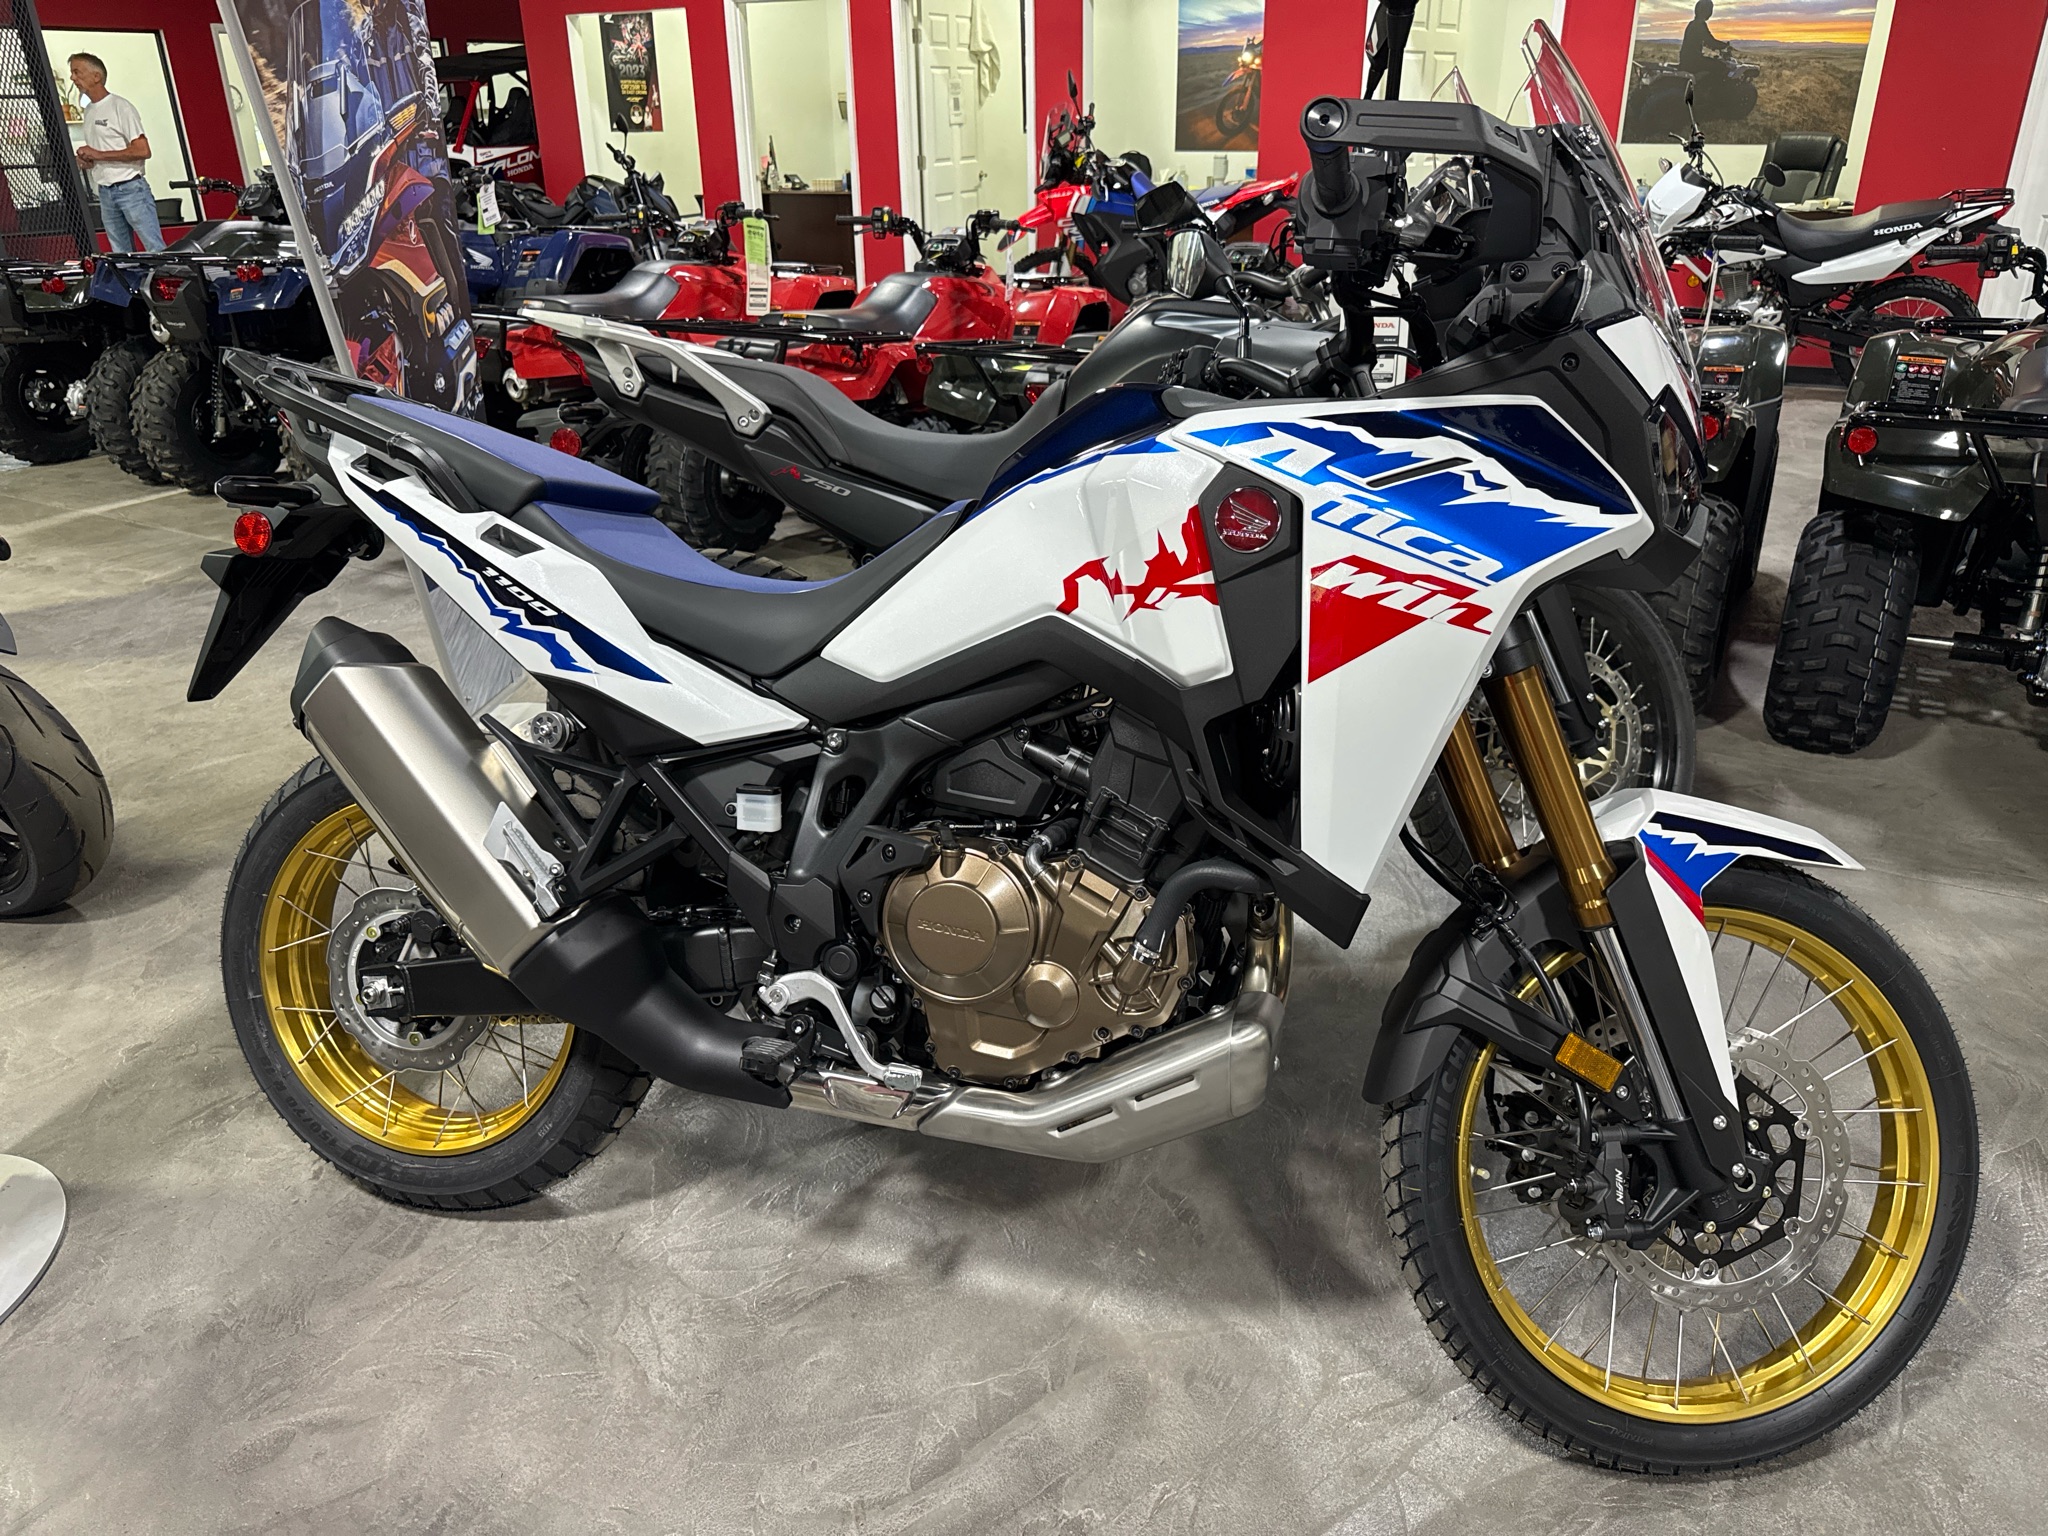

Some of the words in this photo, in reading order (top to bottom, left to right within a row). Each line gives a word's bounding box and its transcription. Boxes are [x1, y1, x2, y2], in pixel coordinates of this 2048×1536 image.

[619, 64, 646, 78] 2023
[482, 150, 541, 175] TALON
[507, 164, 534, 177] HONDA
[1873, 221, 1924, 236] HONDA
[801, 473, 852, 497] 750
[482, 566, 558, 617] 1100
[1311, 560, 1494, 636] win
[917, 919, 986, 943] HONDA
[1430, 1034, 1470, 1146] MICH
[1614, 1167, 1625, 1205] NISSIN
